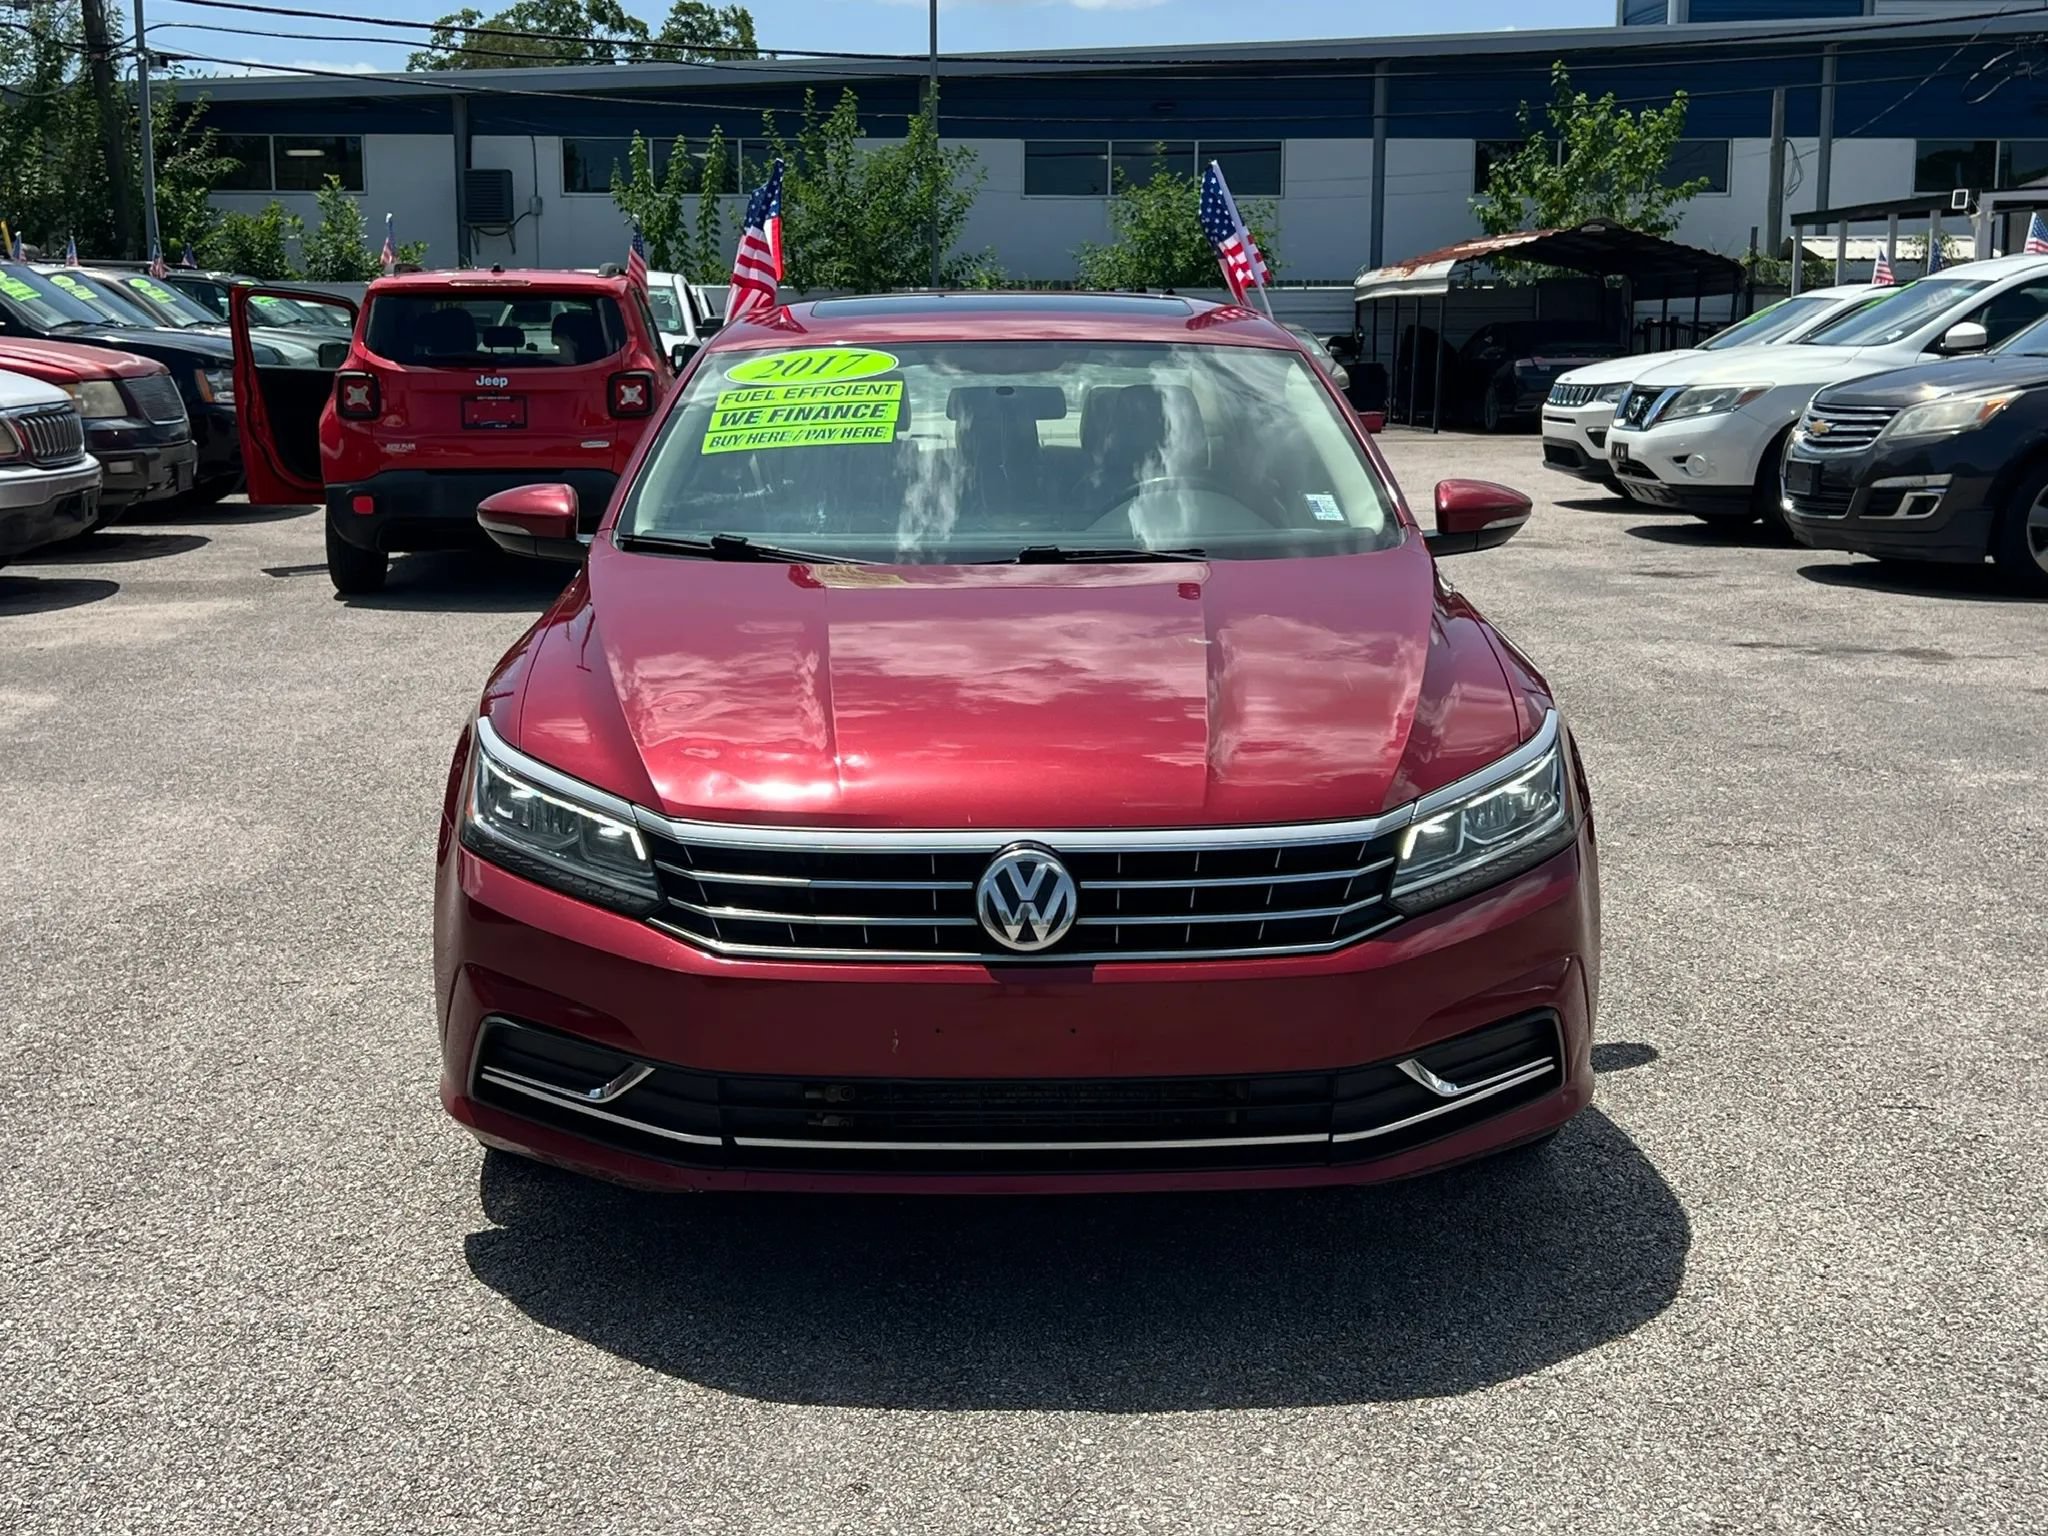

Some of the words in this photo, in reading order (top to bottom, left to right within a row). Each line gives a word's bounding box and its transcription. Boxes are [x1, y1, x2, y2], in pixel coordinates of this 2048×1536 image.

[751, 353, 869, 379] 2017
[476, 375, 508, 388] Jeep
[721, 389, 776, 404] FUEL
[783, 383, 897, 400] EFFICIENT
[719, 410, 764, 427] WE
[767, 403, 889, 423] FINANCE
[709, 433, 745, 448] BUY
[745, 430, 791, 444] HERE
[804, 427, 837, 440] PAY
[840, 426, 887, 439] HERE
[982, 858, 1070, 944] VW
